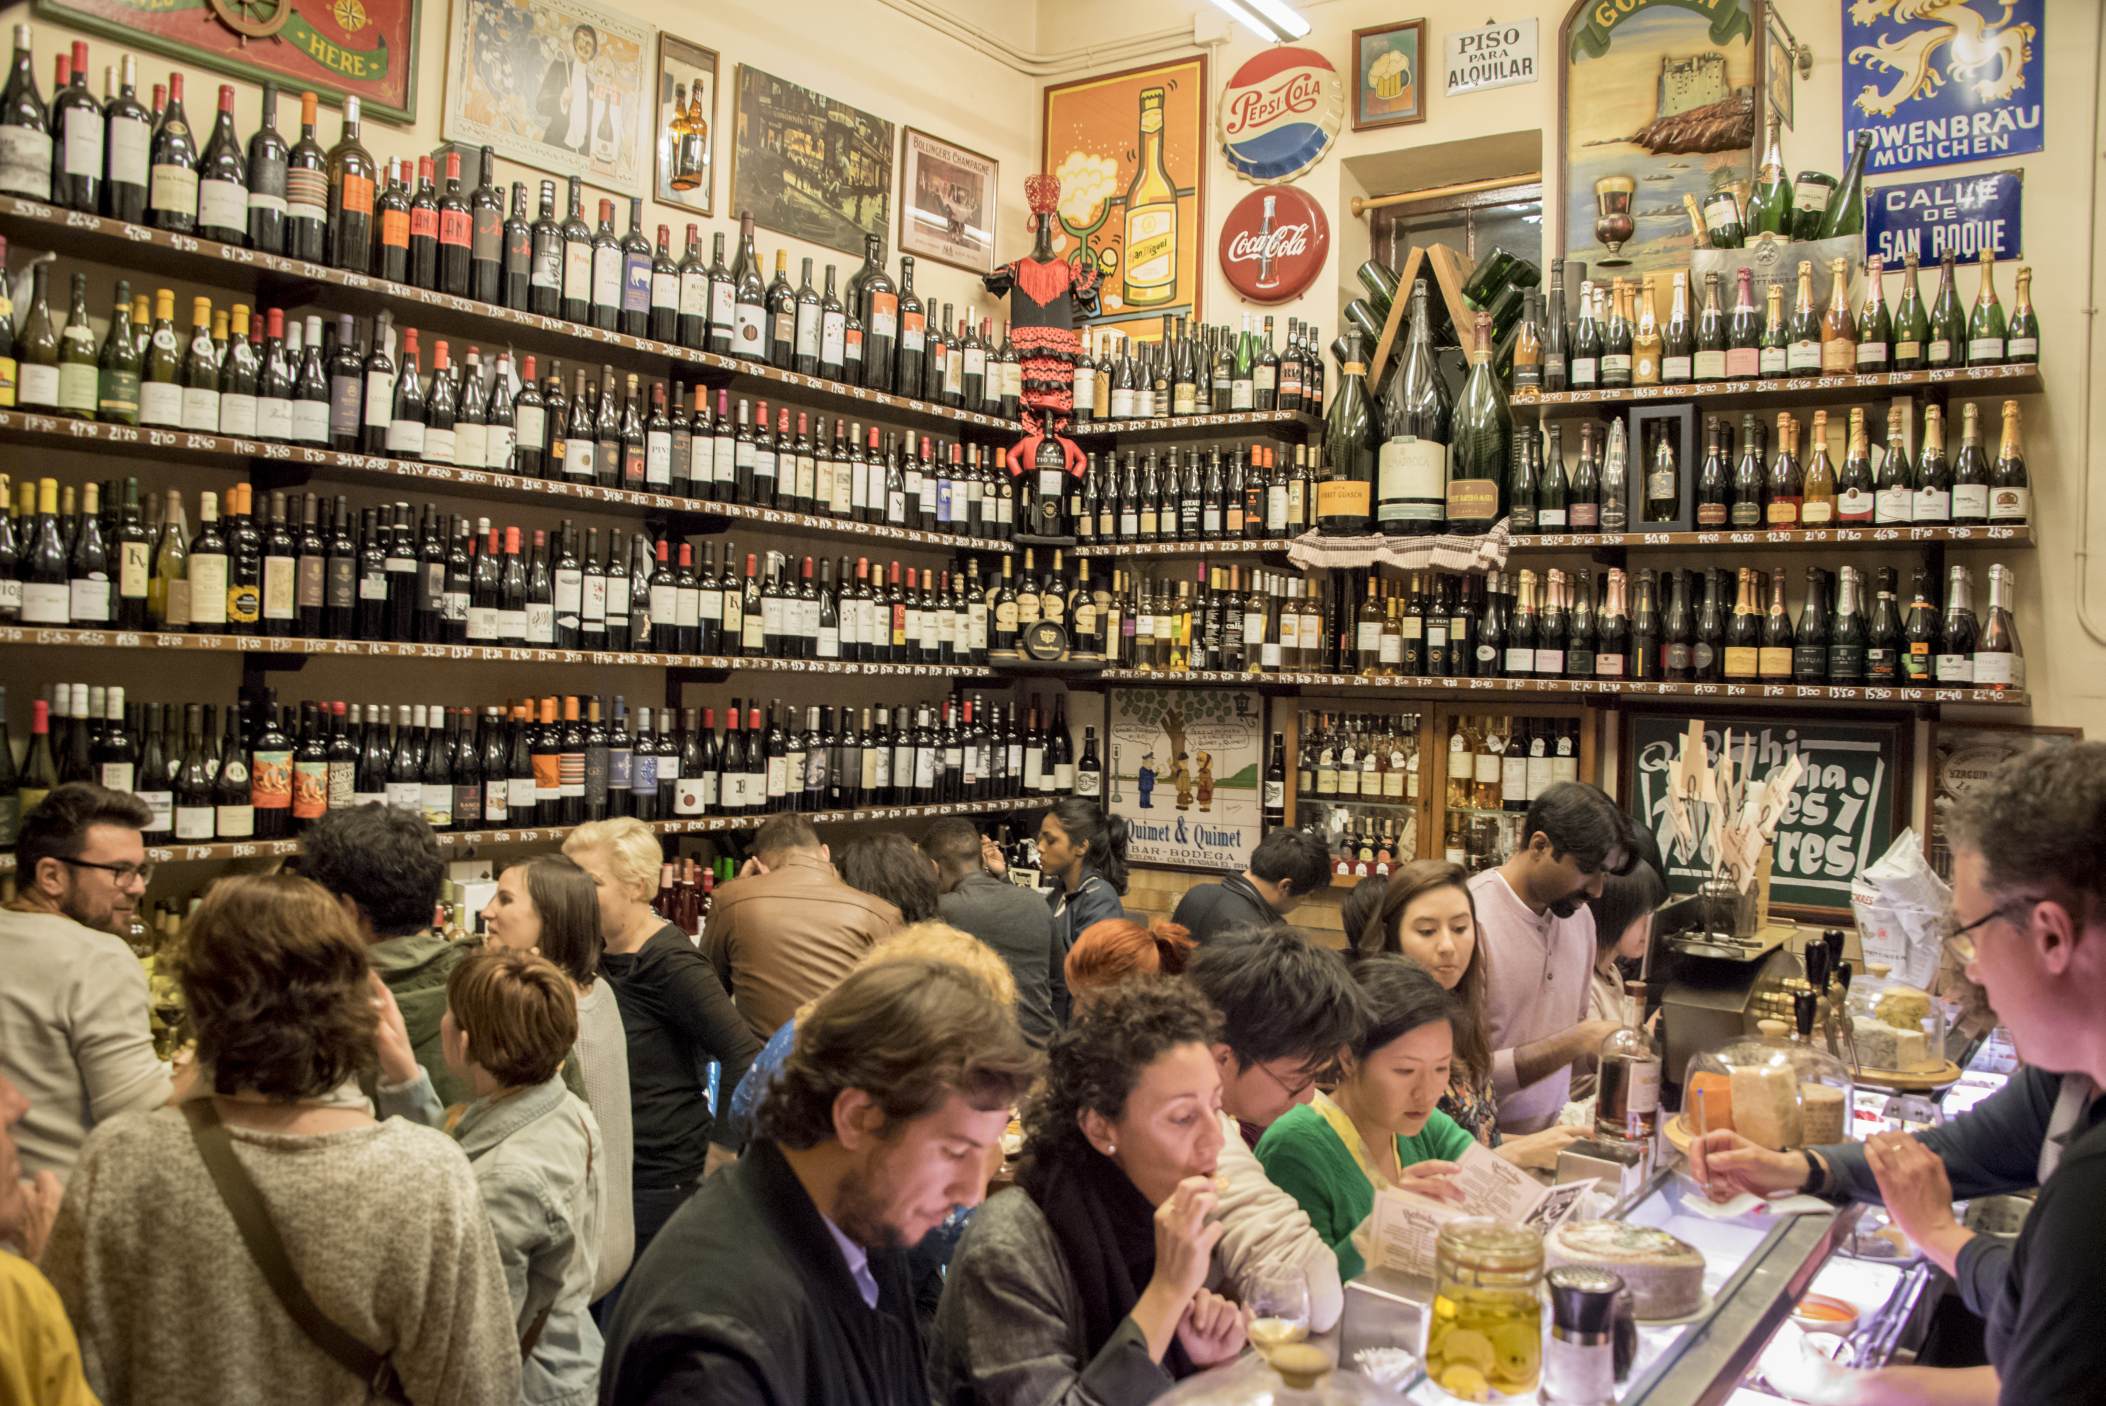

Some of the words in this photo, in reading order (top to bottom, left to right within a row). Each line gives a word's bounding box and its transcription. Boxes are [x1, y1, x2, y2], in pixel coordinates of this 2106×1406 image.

[1458, 28, 1520, 55] PISO
[1469, 49, 1509, 63] PARA
[308, 39, 368, 77] HERE
[1448, 57, 1533, 88] ALQUILAR
[952, 151, 990, 176] CHAMPAGNE
[1874, 134, 2009, 167] MÜNCHEN
[1886, 178, 1999, 211] CALLE
[1923, 206, 1958, 222] DE
[1879, 228, 1921, 263] SAN
[1932, 219, 2006, 259] ROQUE
[1127, 818, 1170, 843] Quimet
[1174, 815, 1190, 845] &
[1194, 824, 1241, 850] Quimet
